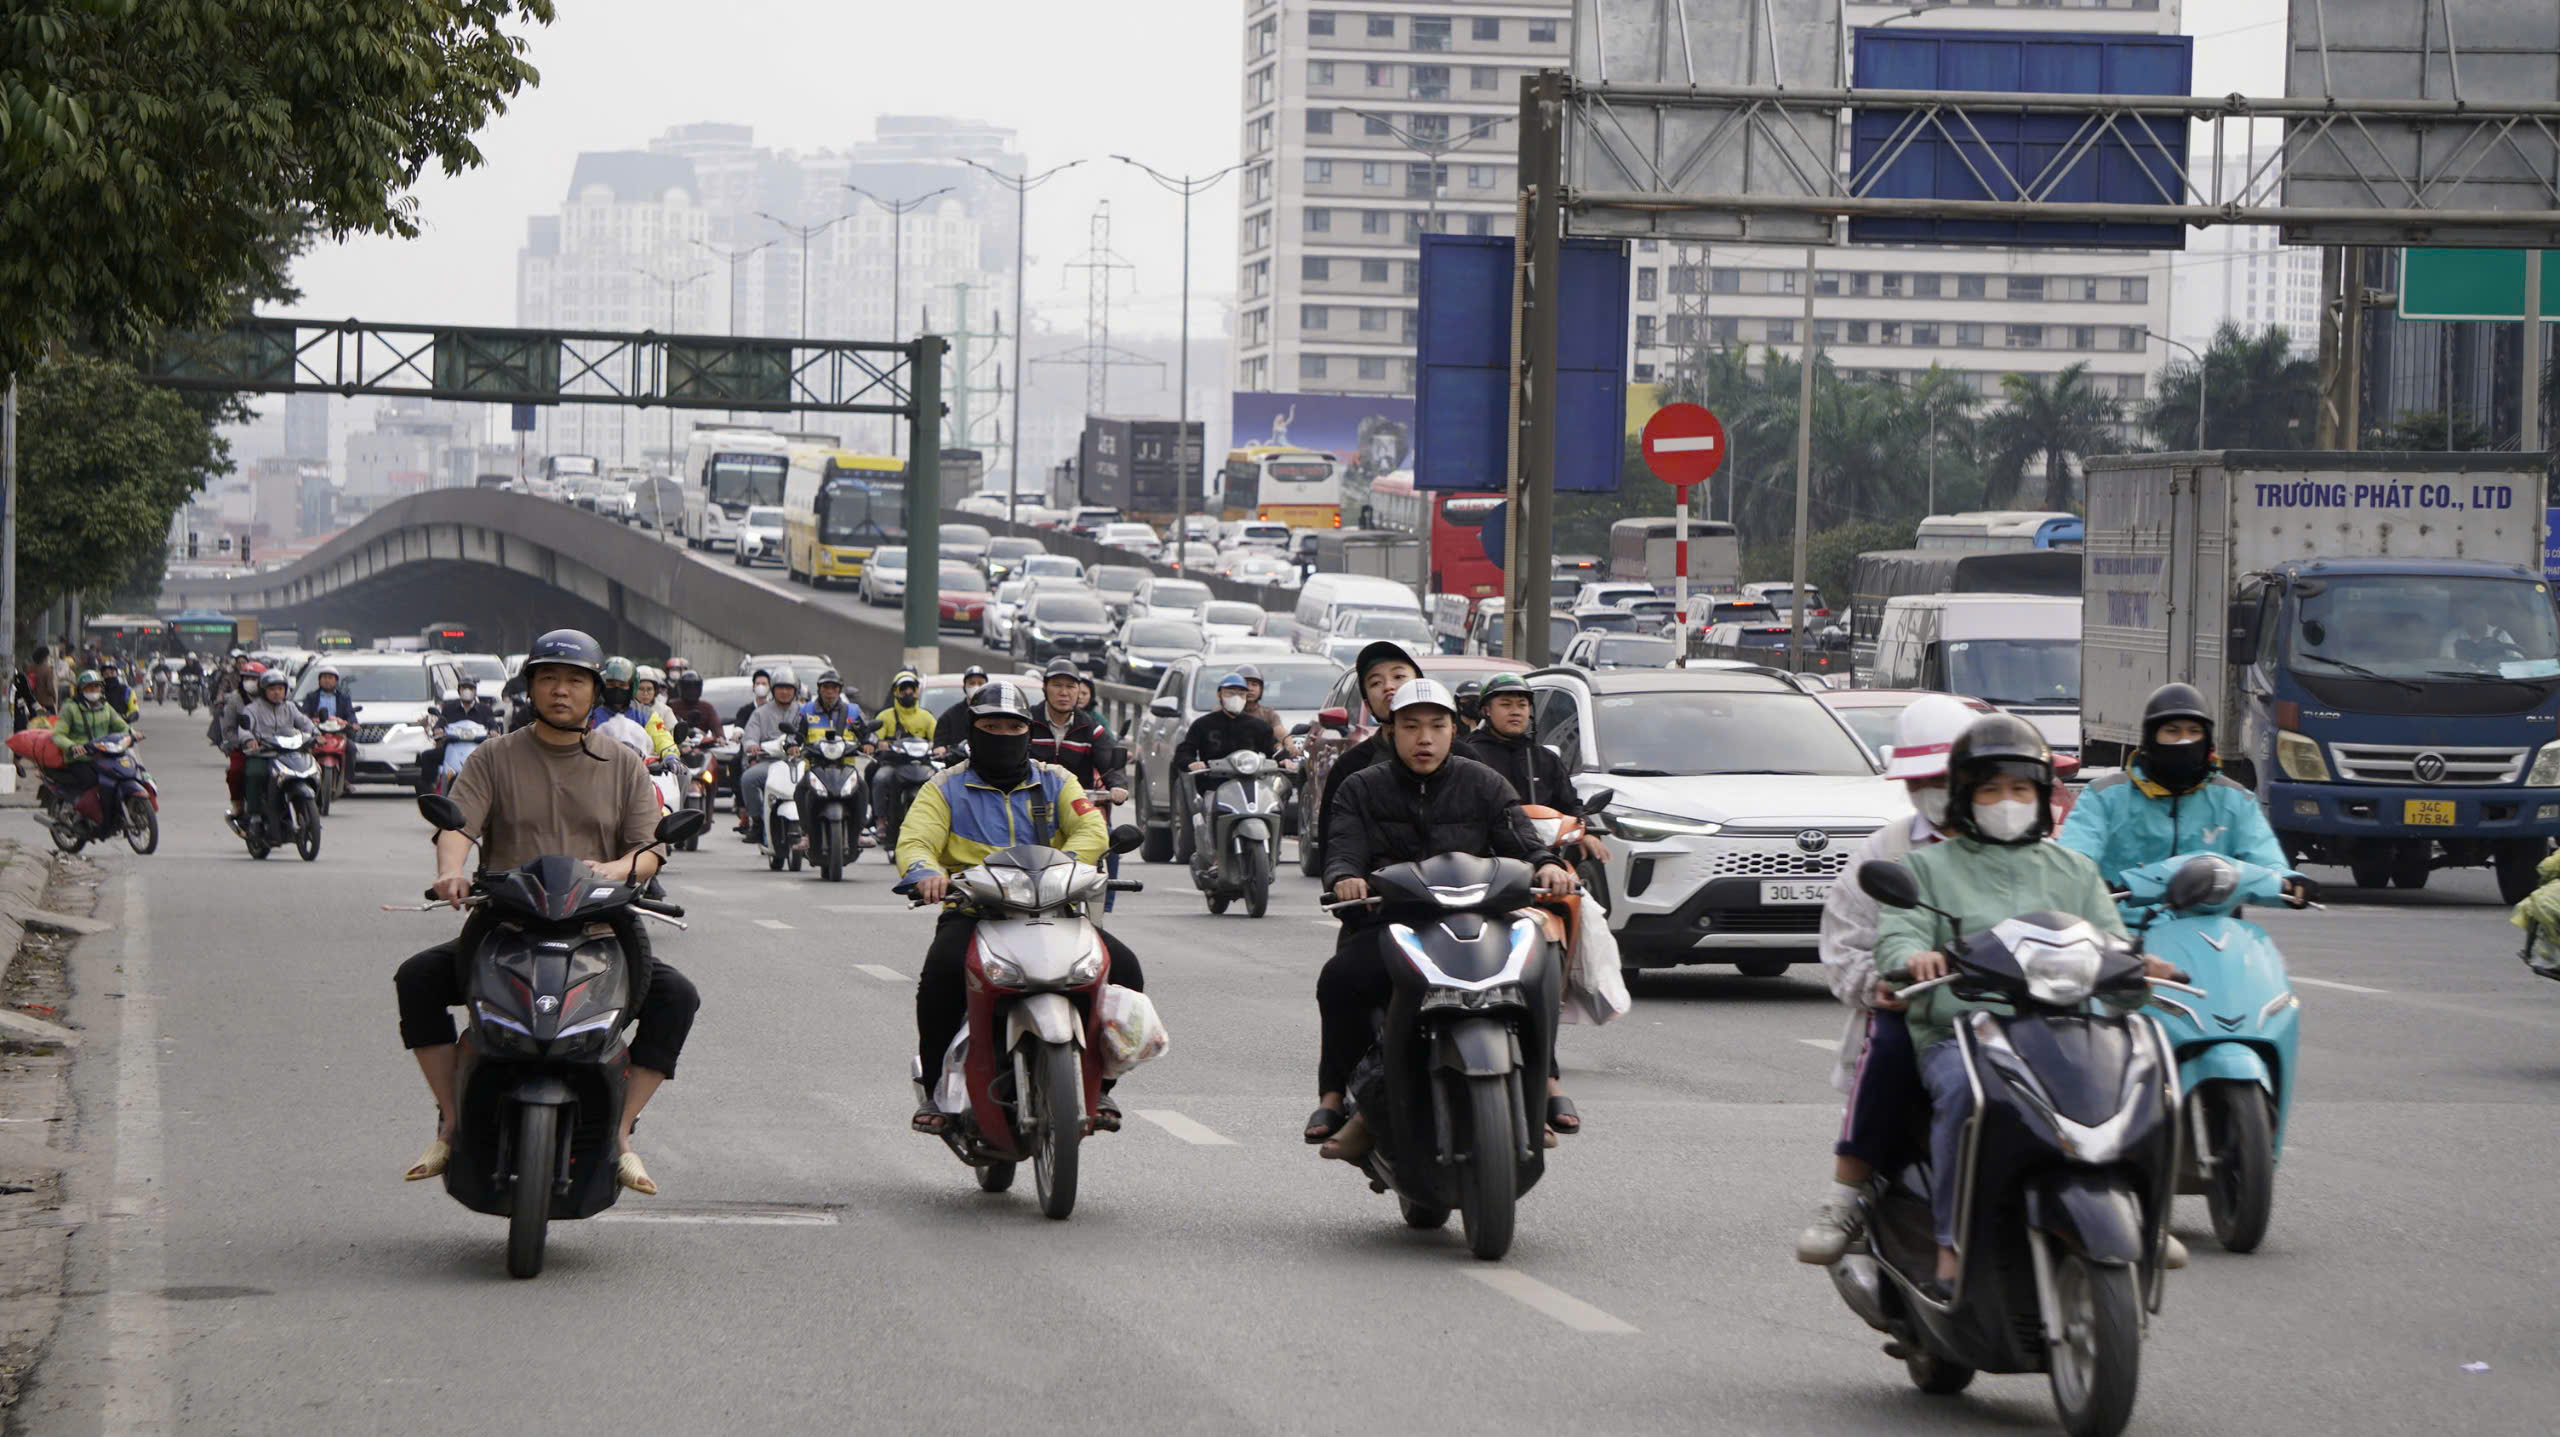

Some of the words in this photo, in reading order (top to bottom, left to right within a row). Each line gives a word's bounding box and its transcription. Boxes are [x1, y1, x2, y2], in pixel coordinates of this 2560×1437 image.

[2255, 477, 2346, 507] TRƯỜNG
[2354, 479, 2414, 508] PHÁT
[2420, 484, 2464, 512] CO.,
[2472, 486, 2511, 509] LTD
[2419, 802, 2441, 813] 34C
[2411, 813, 2449, 825] 176.84
